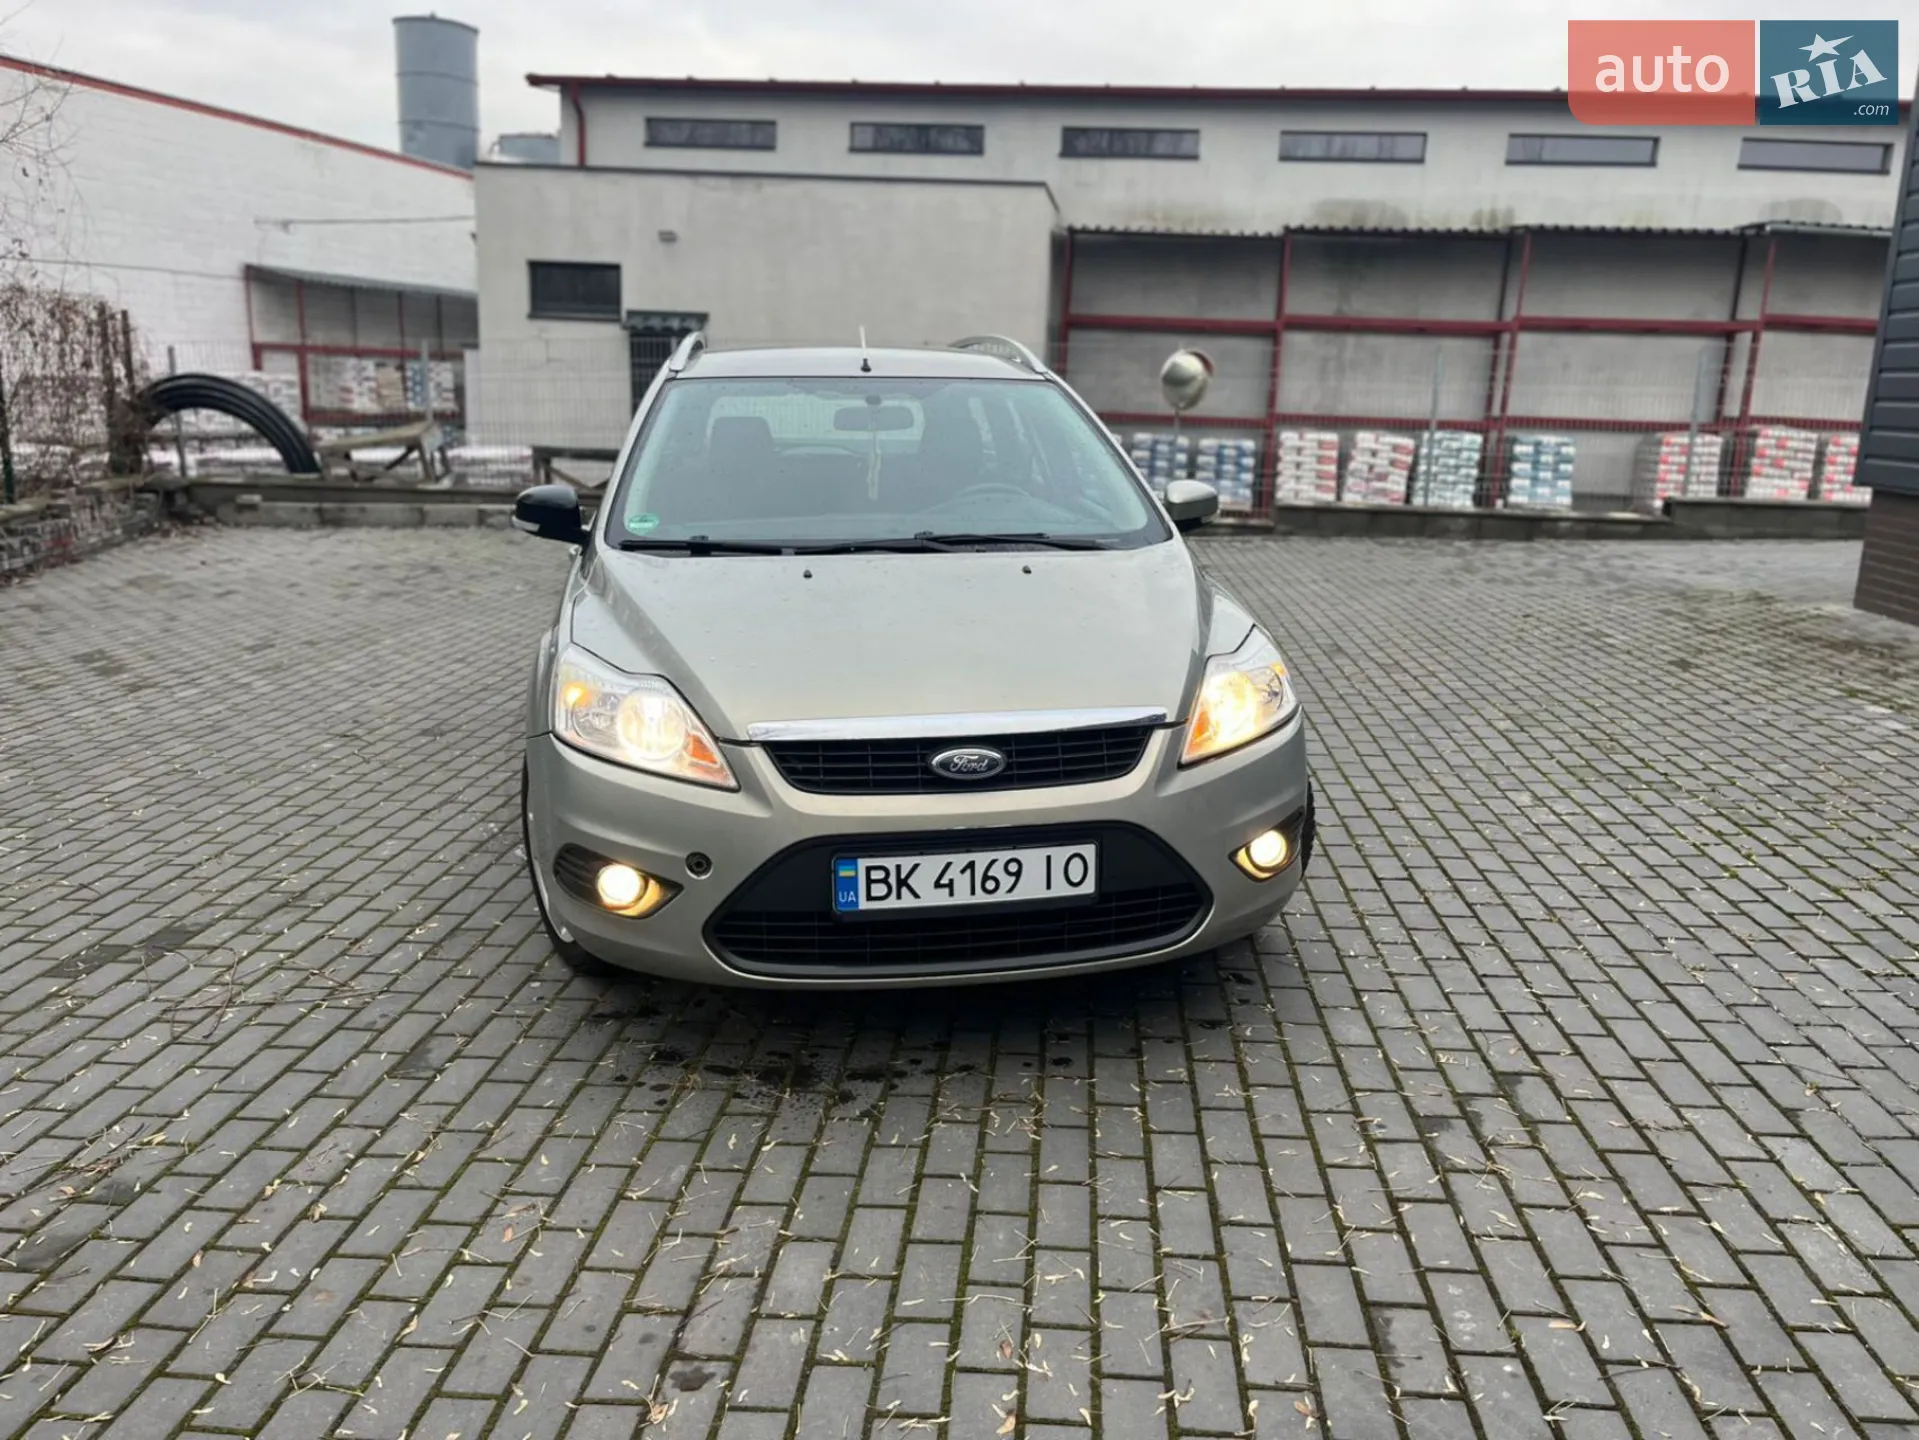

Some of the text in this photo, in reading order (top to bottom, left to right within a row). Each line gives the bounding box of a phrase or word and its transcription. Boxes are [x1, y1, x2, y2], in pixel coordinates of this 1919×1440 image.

[950, 754, 989, 772] Ford
[865, 852, 1089, 902] BK 4169 IO
[838, 891, 857, 903] UA
